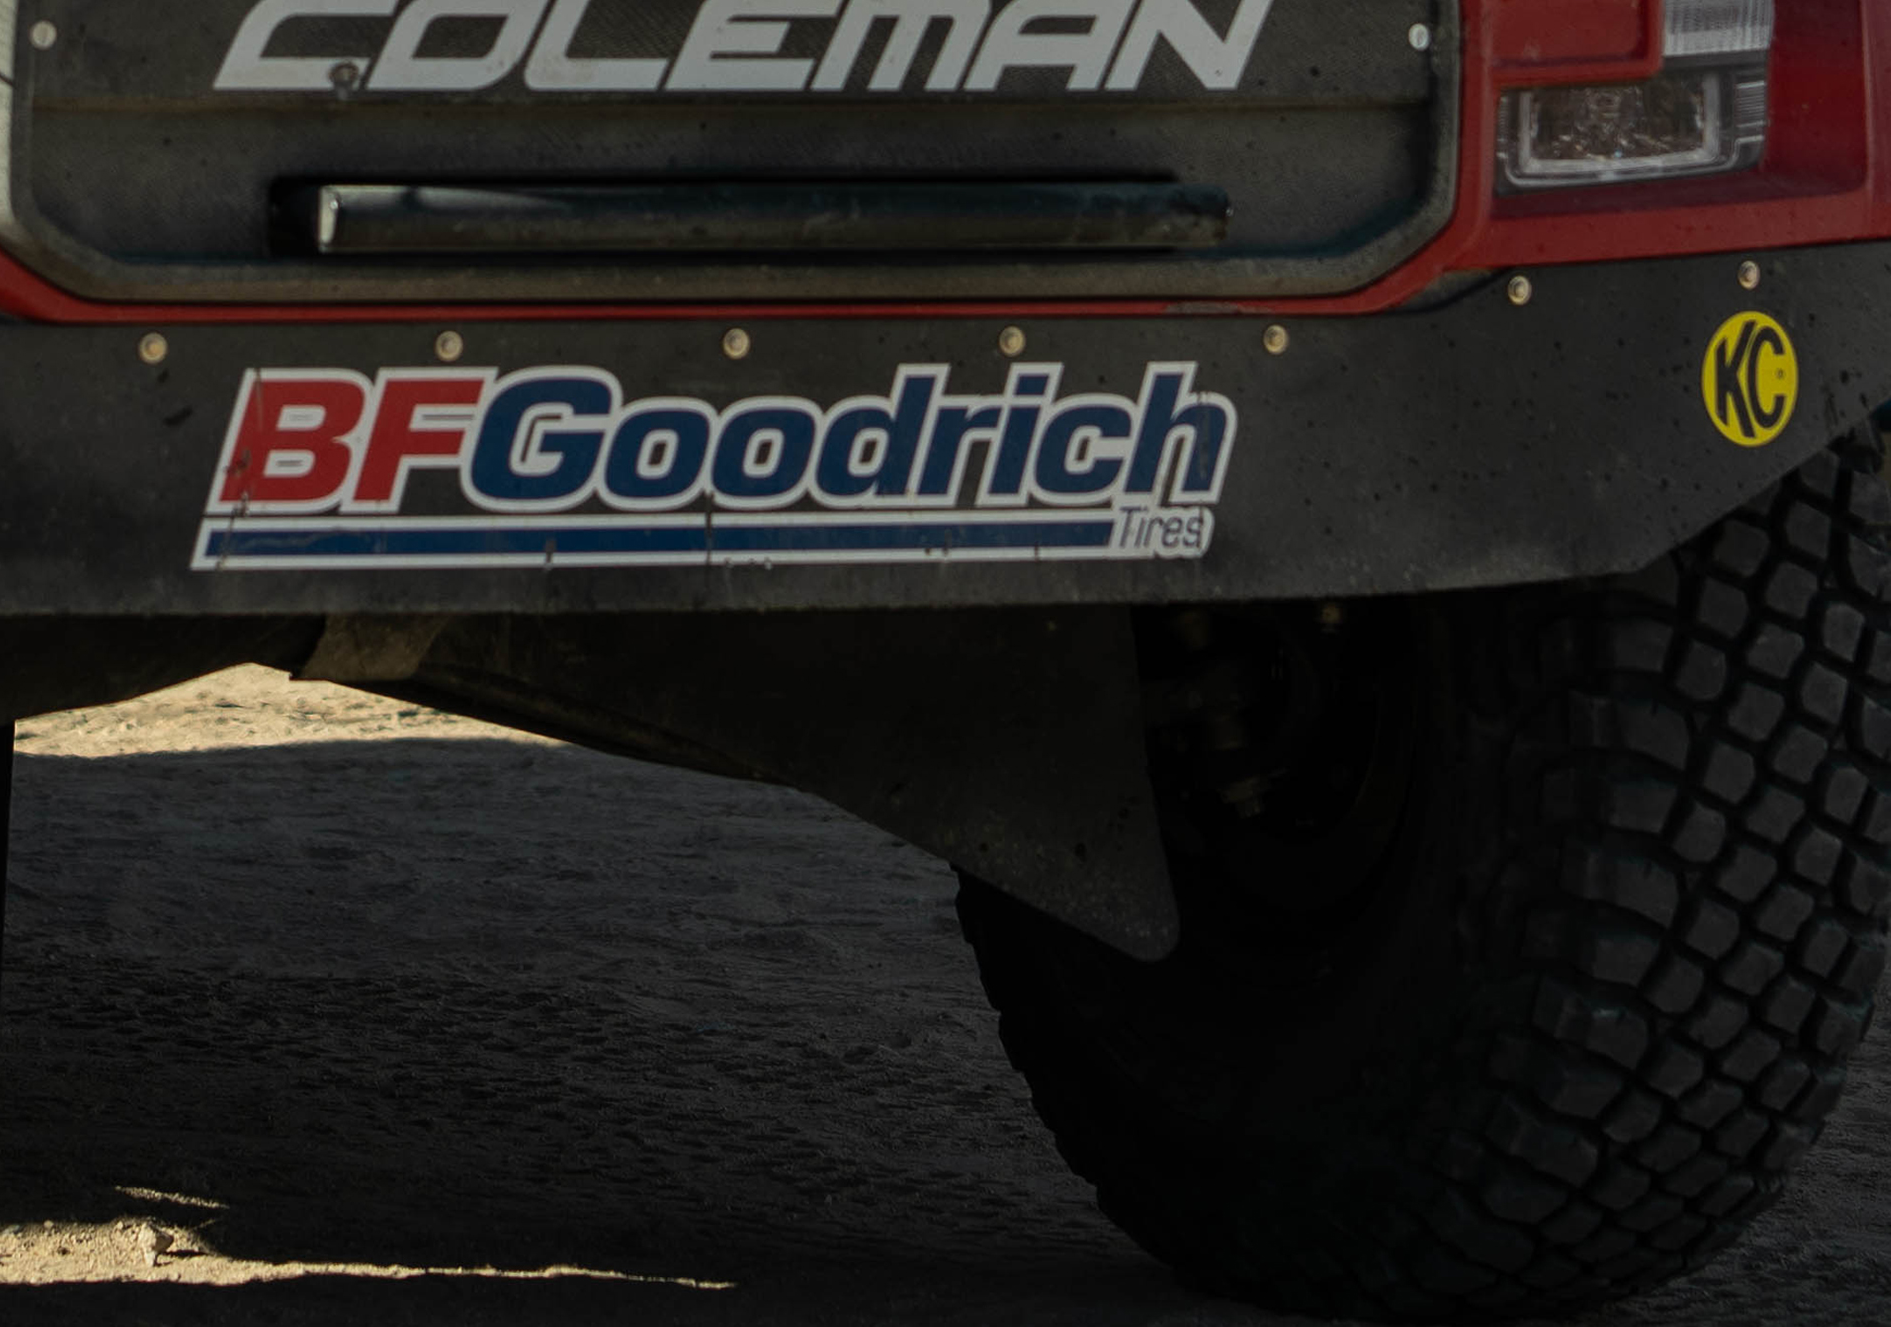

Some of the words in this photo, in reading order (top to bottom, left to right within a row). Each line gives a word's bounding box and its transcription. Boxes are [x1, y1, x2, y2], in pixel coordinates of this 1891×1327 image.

[1715, 320, 1786, 438] KC
[217, 363, 1237, 515] BFGoodrich
[1111, 507, 1213, 559] Tires
